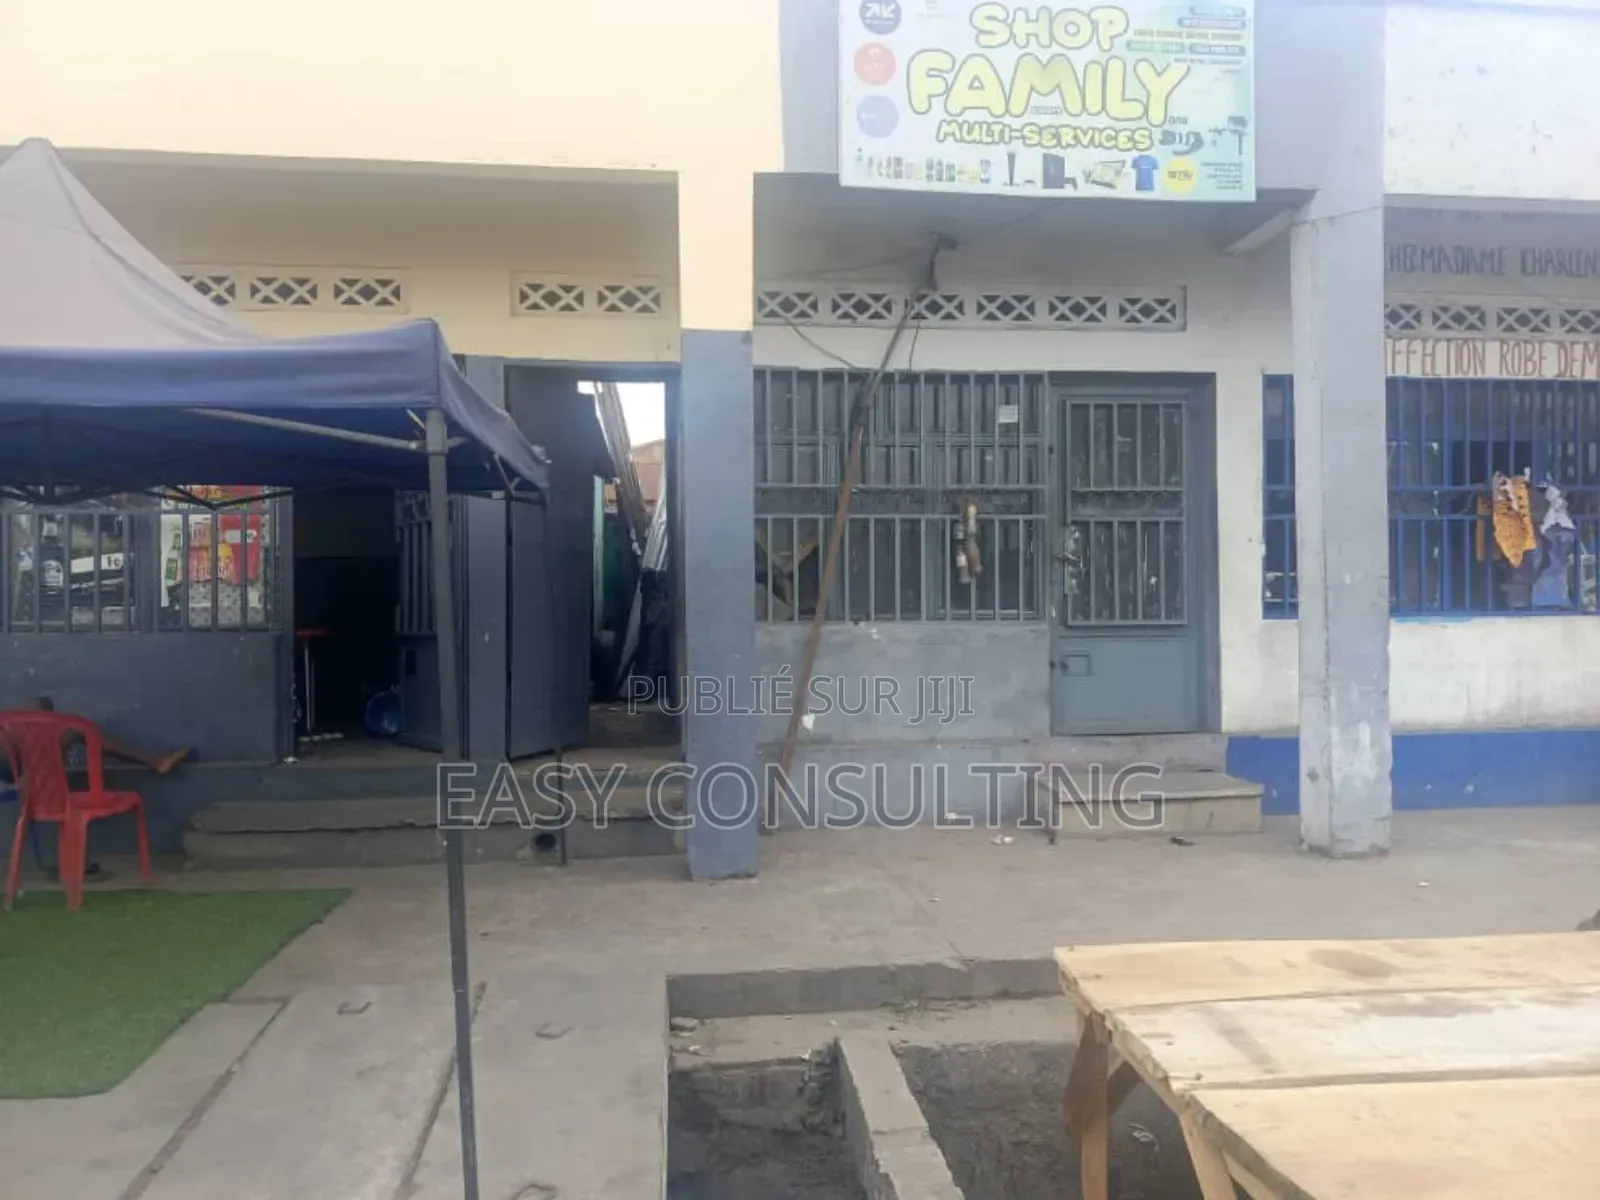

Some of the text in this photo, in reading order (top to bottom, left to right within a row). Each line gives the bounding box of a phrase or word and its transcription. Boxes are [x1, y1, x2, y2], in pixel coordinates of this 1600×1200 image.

[970, 2, 1128, 50] SHOP
[907, 50, 1190, 126] FAMILY
[936, 120, 1153, 151] MULTI-SERVICES
[1384, 339, 1486, 376] FFECTION
[1499, 341, 1547, 377] ROBE
